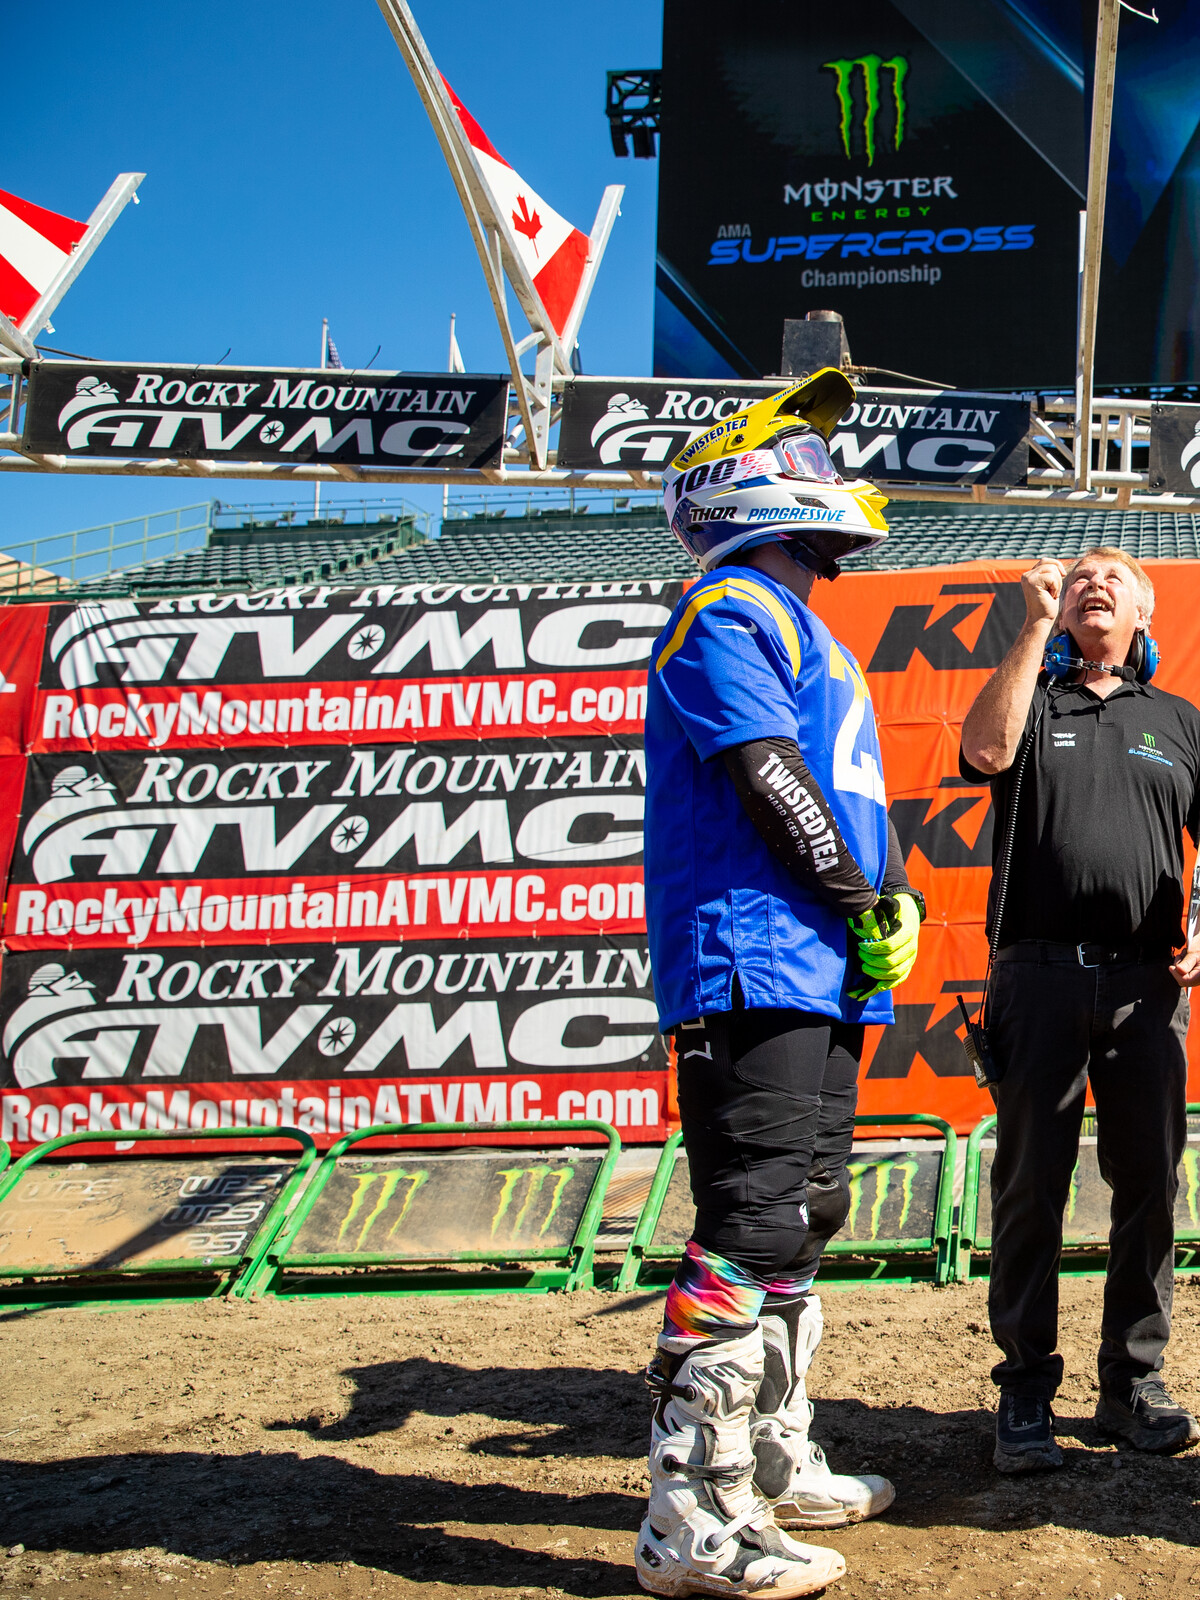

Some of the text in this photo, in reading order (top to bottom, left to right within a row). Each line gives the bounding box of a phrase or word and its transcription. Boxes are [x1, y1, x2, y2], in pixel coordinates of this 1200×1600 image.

[783, 176, 958, 207] MONSTER
[717, 224, 752, 239] AMA
[811, 206, 931, 222] ENERGY
[707, 225, 1036, 265] SUPERCROSS
[801, 265, 942, 289] Championship
[125, 374, 477, 415] ROCKY MOUNTAIN
[655, 391, 1000, 433] ROC OUNTAIN
[680, 418, 748, 463] TWISTED TEA
[689, 506, 738, 522] THOR
[747, 507, 846, 522] PROGRESSIVE
[126, 748, 647, 803] ROCKY MOUNTAIN
[757, 752, 839, 872] TWISTED TEA
[767, 794, 807, 856] HARD ICED TEA
[106, 946, 652, 1003] ROCKY MOUNTAIN
[179, 1173, 283, 1198] WPS
[160, 1201, 266, 1227] WPS
